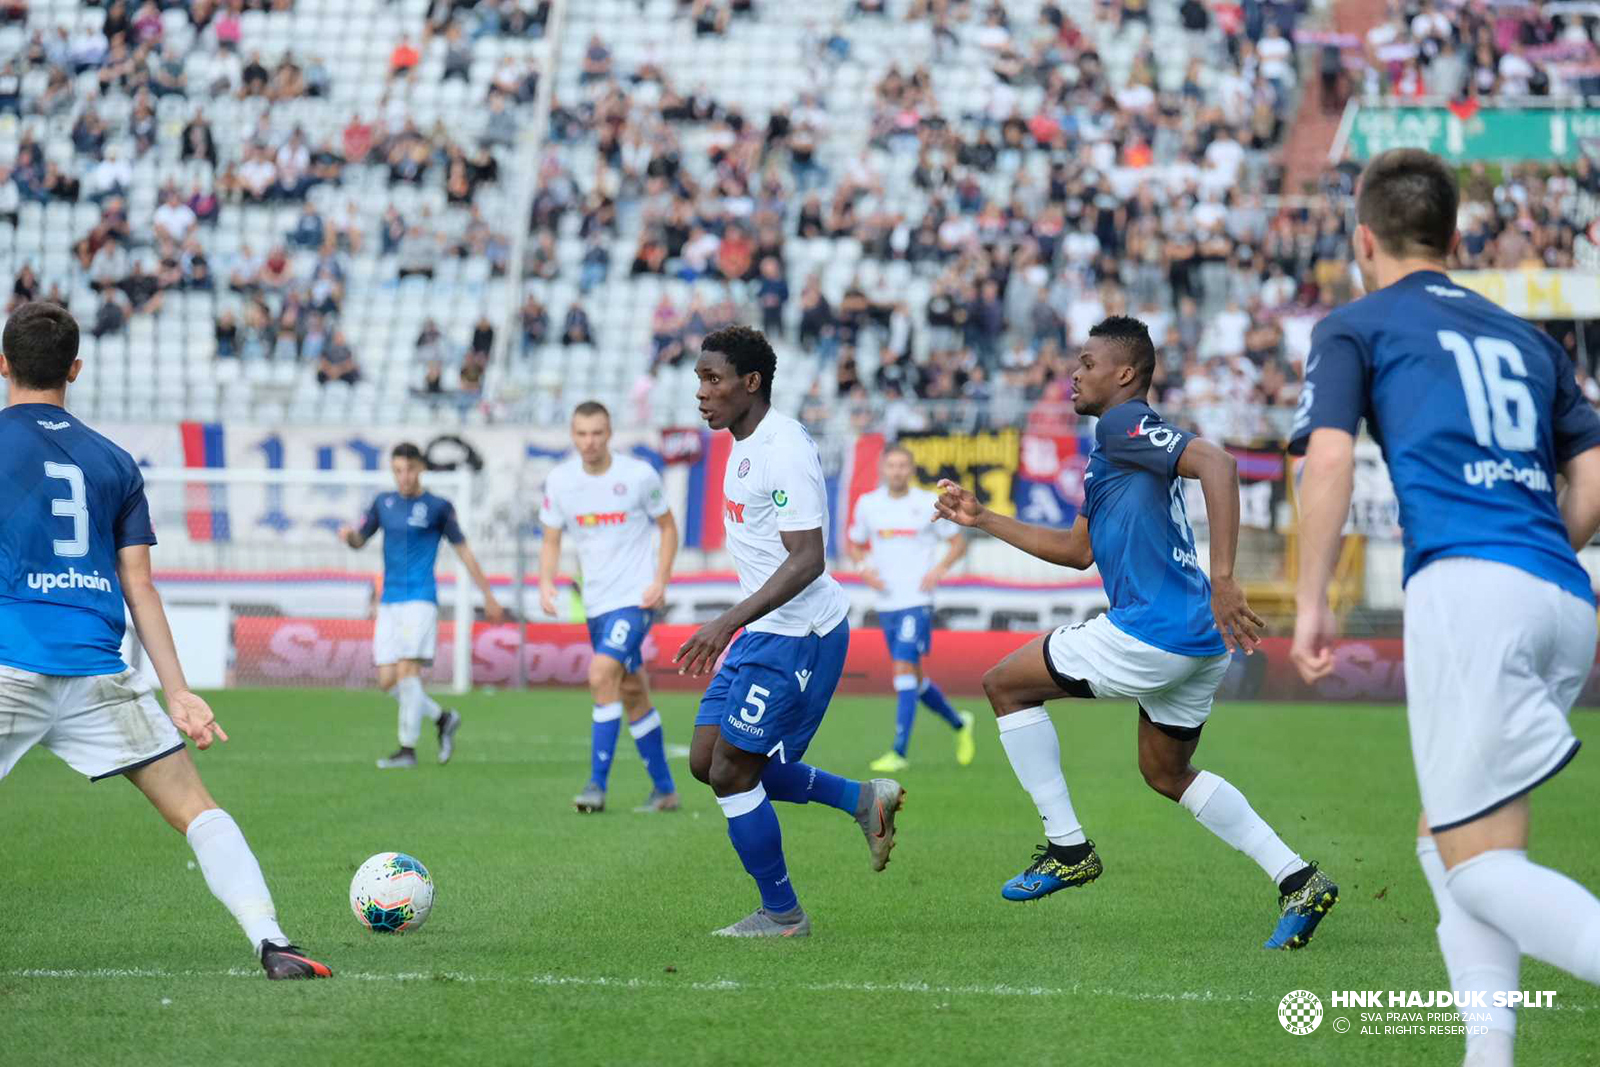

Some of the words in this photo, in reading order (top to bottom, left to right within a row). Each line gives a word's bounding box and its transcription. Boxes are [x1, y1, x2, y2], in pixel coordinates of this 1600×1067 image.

[1437, 330, 1538, 452] 16
[44, 461, 90, 557] 3
[27, 568, 112, 593] upchain
[610, 618, 631, 645] 6
[740, 683, 771, 724] 5
[727, 714, 765, 737] macron
